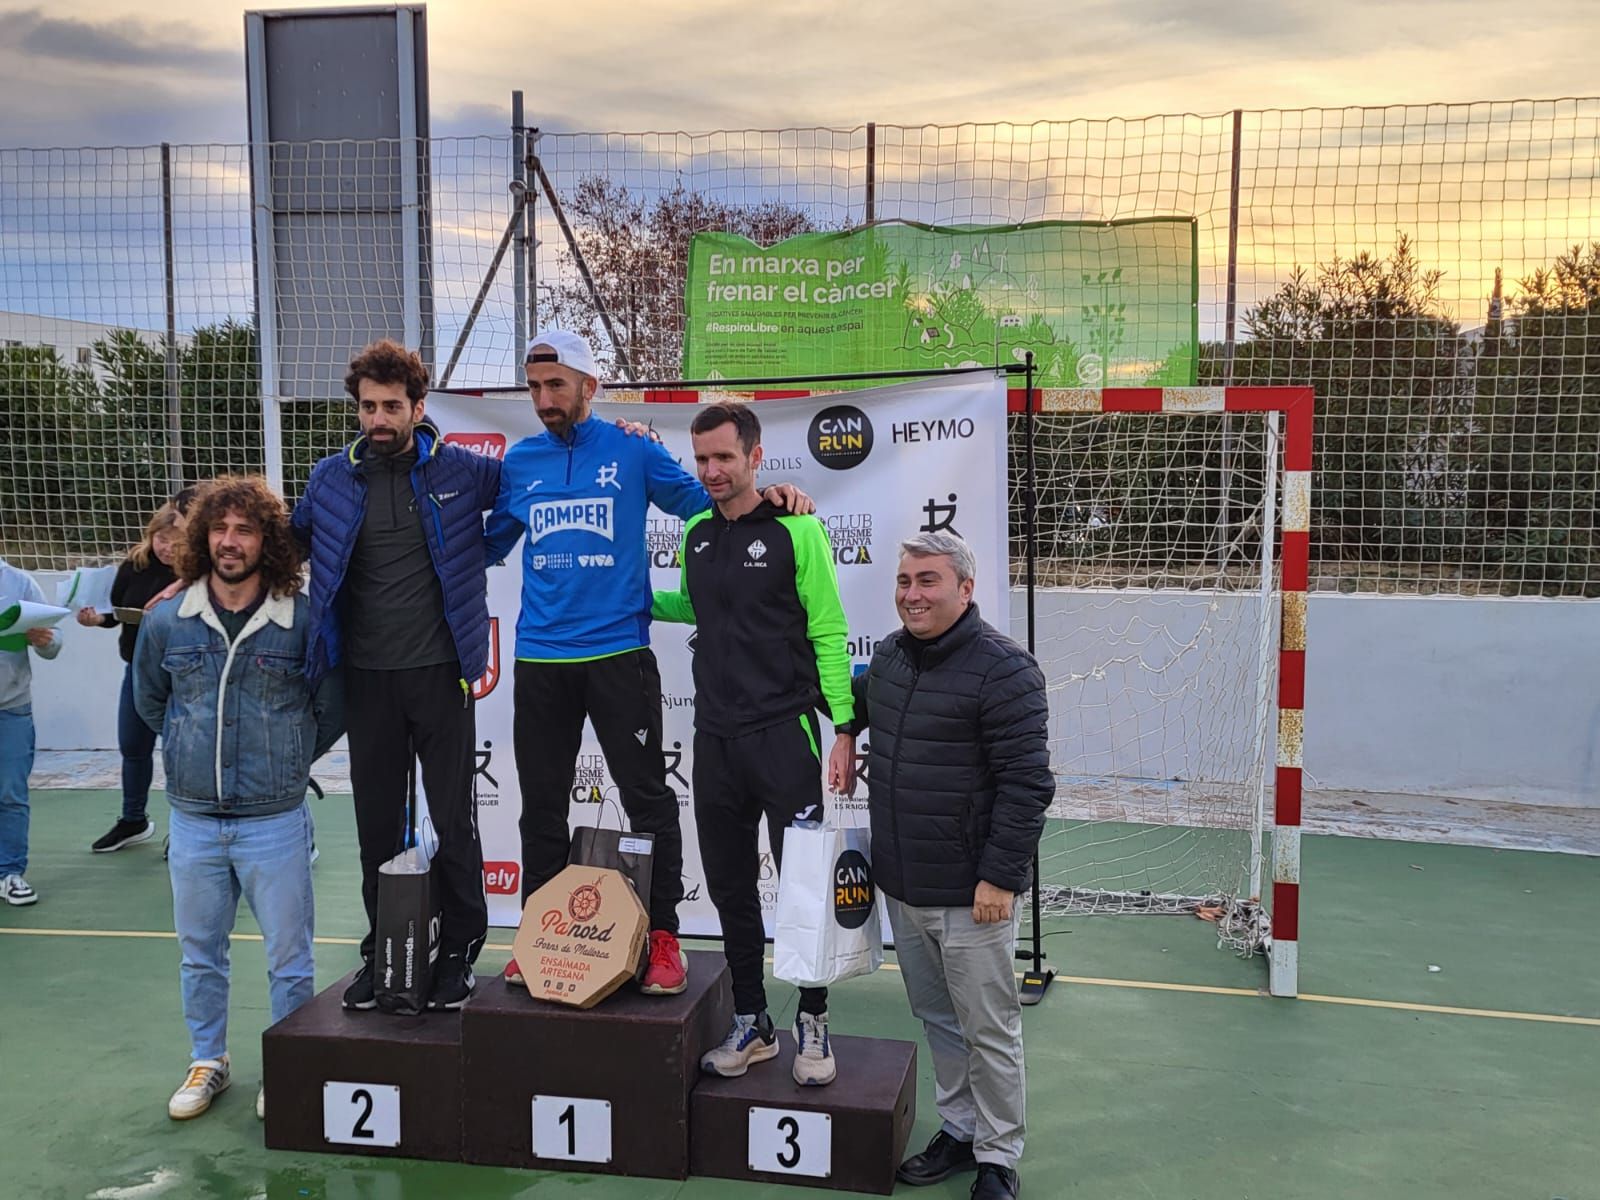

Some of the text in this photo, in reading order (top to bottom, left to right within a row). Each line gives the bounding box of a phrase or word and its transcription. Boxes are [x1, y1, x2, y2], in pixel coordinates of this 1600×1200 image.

[709, 254, 865, 282] En marxa per
[706, 277, 897, 304] frenar el càncer
[705, 320, 864, 335] #RespiroLibre en aquest espai
[819, 417, 862, 434] CAN
[892, 418, 975, 444] HEYMO
[819, 434, 863, 450] RUN
[760, 456, 803, 471] RDILS
[533, 503, 608, 534] CAMPER
[827, 513, 873, 530] CLUB
[827, 528, 872, 539] LETISME
[830, 537, 872, 547] NTANYA
[578, 554, 615, 568] VIVA
[660, 693, 693, 709] Ajun
[574, 777, 604, 786] TANYA
[836, 866, 868, 885] CAN
[836, 887, 869, 905] RUN
[404, 920, 416, 989] onesmoda.com
[561, 942, 571, 953] de
[574, 943, 610, 959] Mallorca
[384, 937, 394, 988] shop online
[540, 956, 591, 972] ENSAÏMADA
[540, 967, 585, 982] ARTESANA
[351, 1089, 374, 1138] 2
[558, 1104, 577, 1156] 1
[776, 1116, 801, 1168] 3
